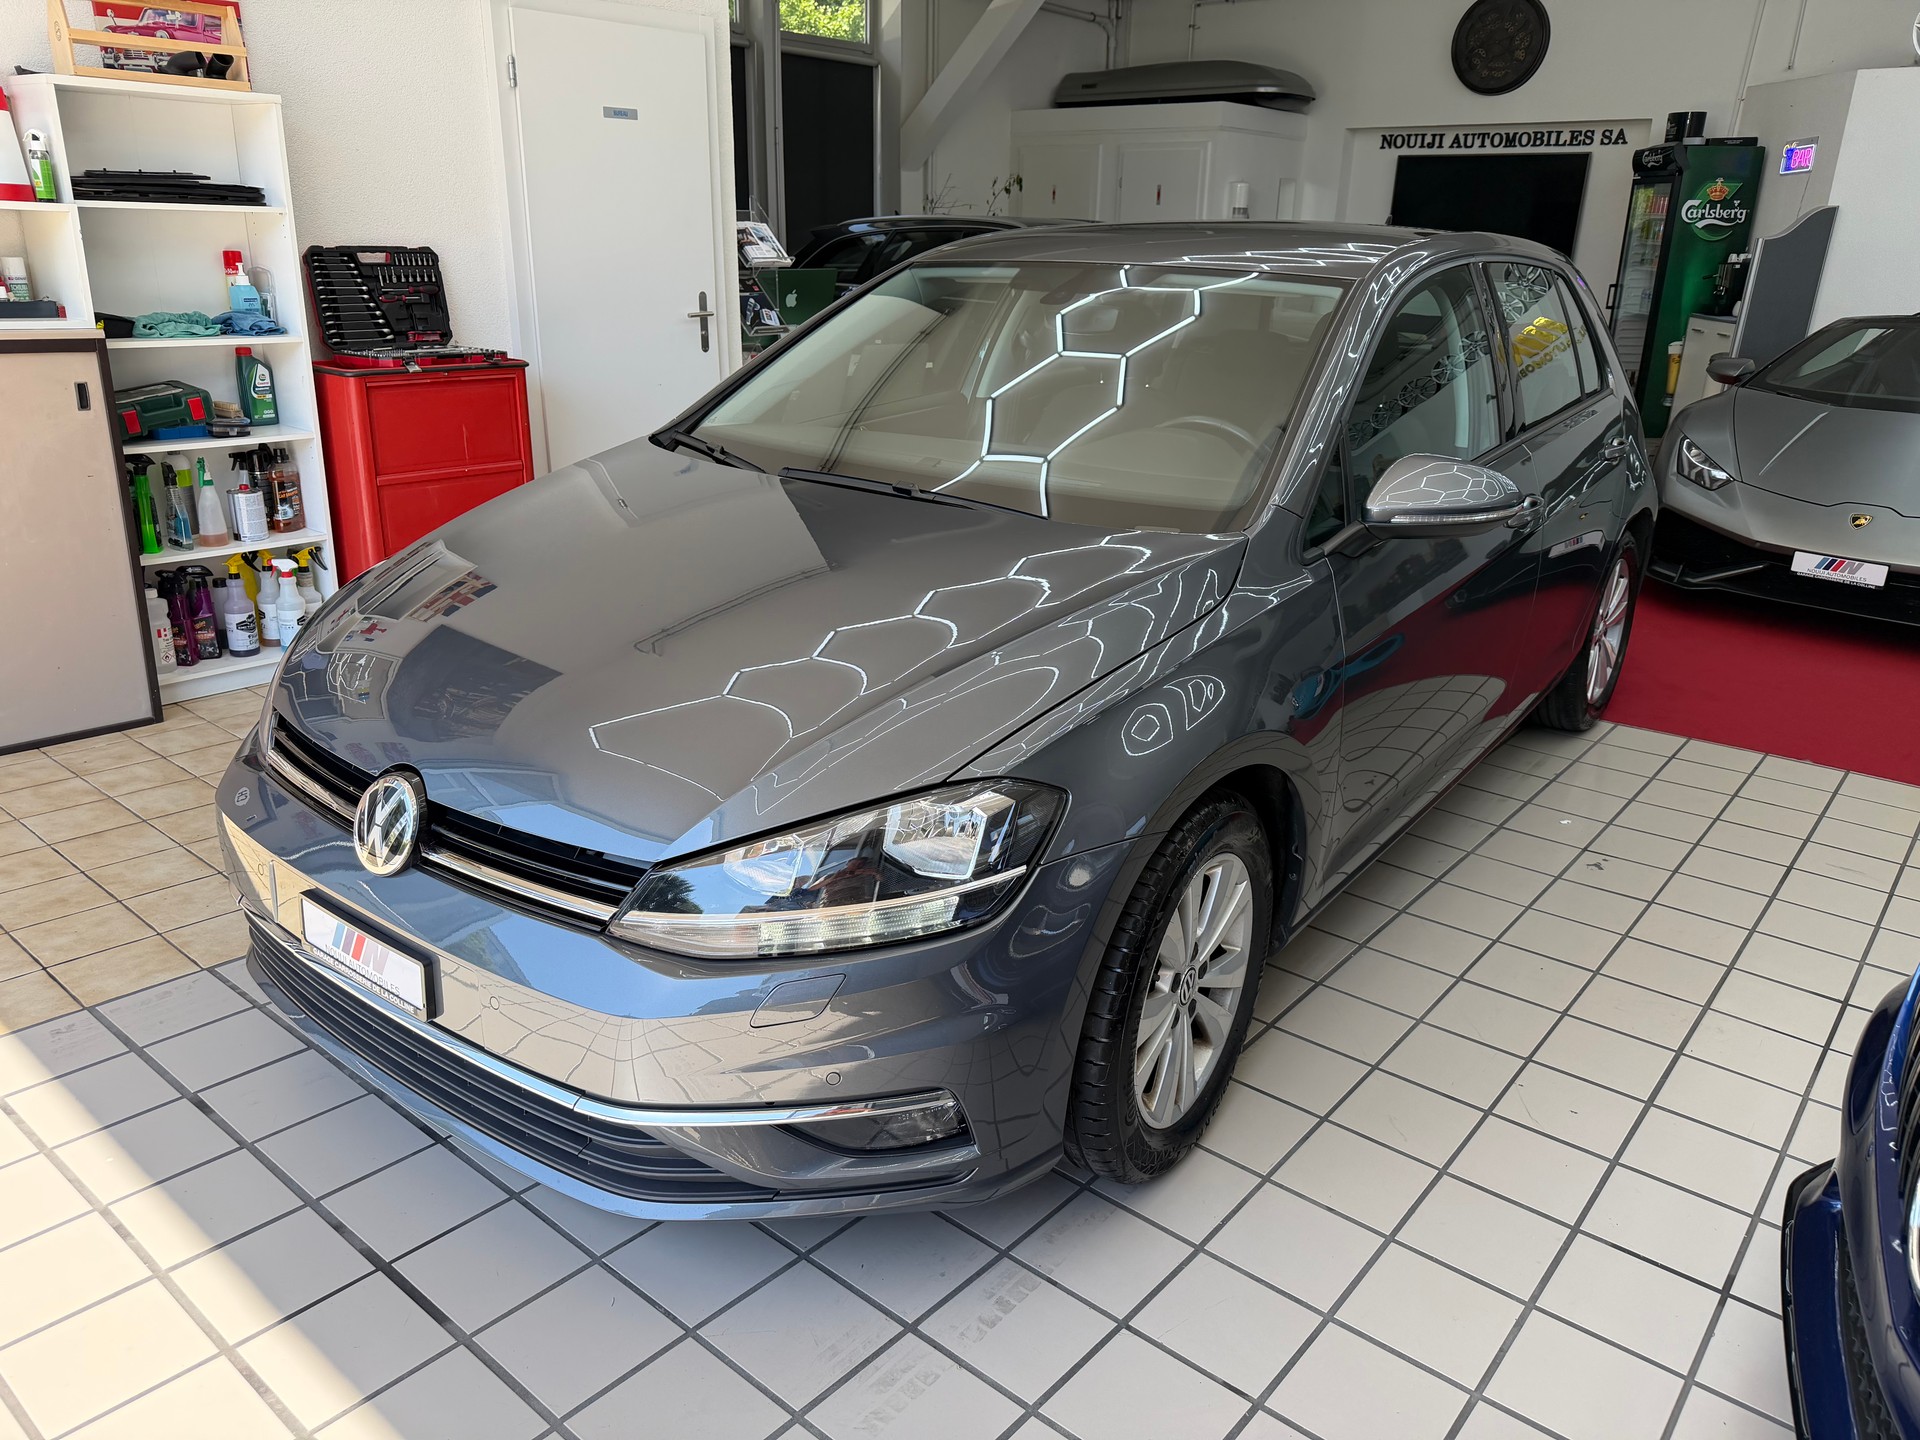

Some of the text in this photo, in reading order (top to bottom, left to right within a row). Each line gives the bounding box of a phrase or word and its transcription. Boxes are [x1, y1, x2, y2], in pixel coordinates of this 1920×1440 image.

[1380, 128, 1628, 150] NOUIJI AUTOMOBILES SA
[1791, 147, 1812, 169] BAR
[1681, 199, 1748, 227] Carlsberg
[1826, 571, 1867, 582] AUTOMOBILES
